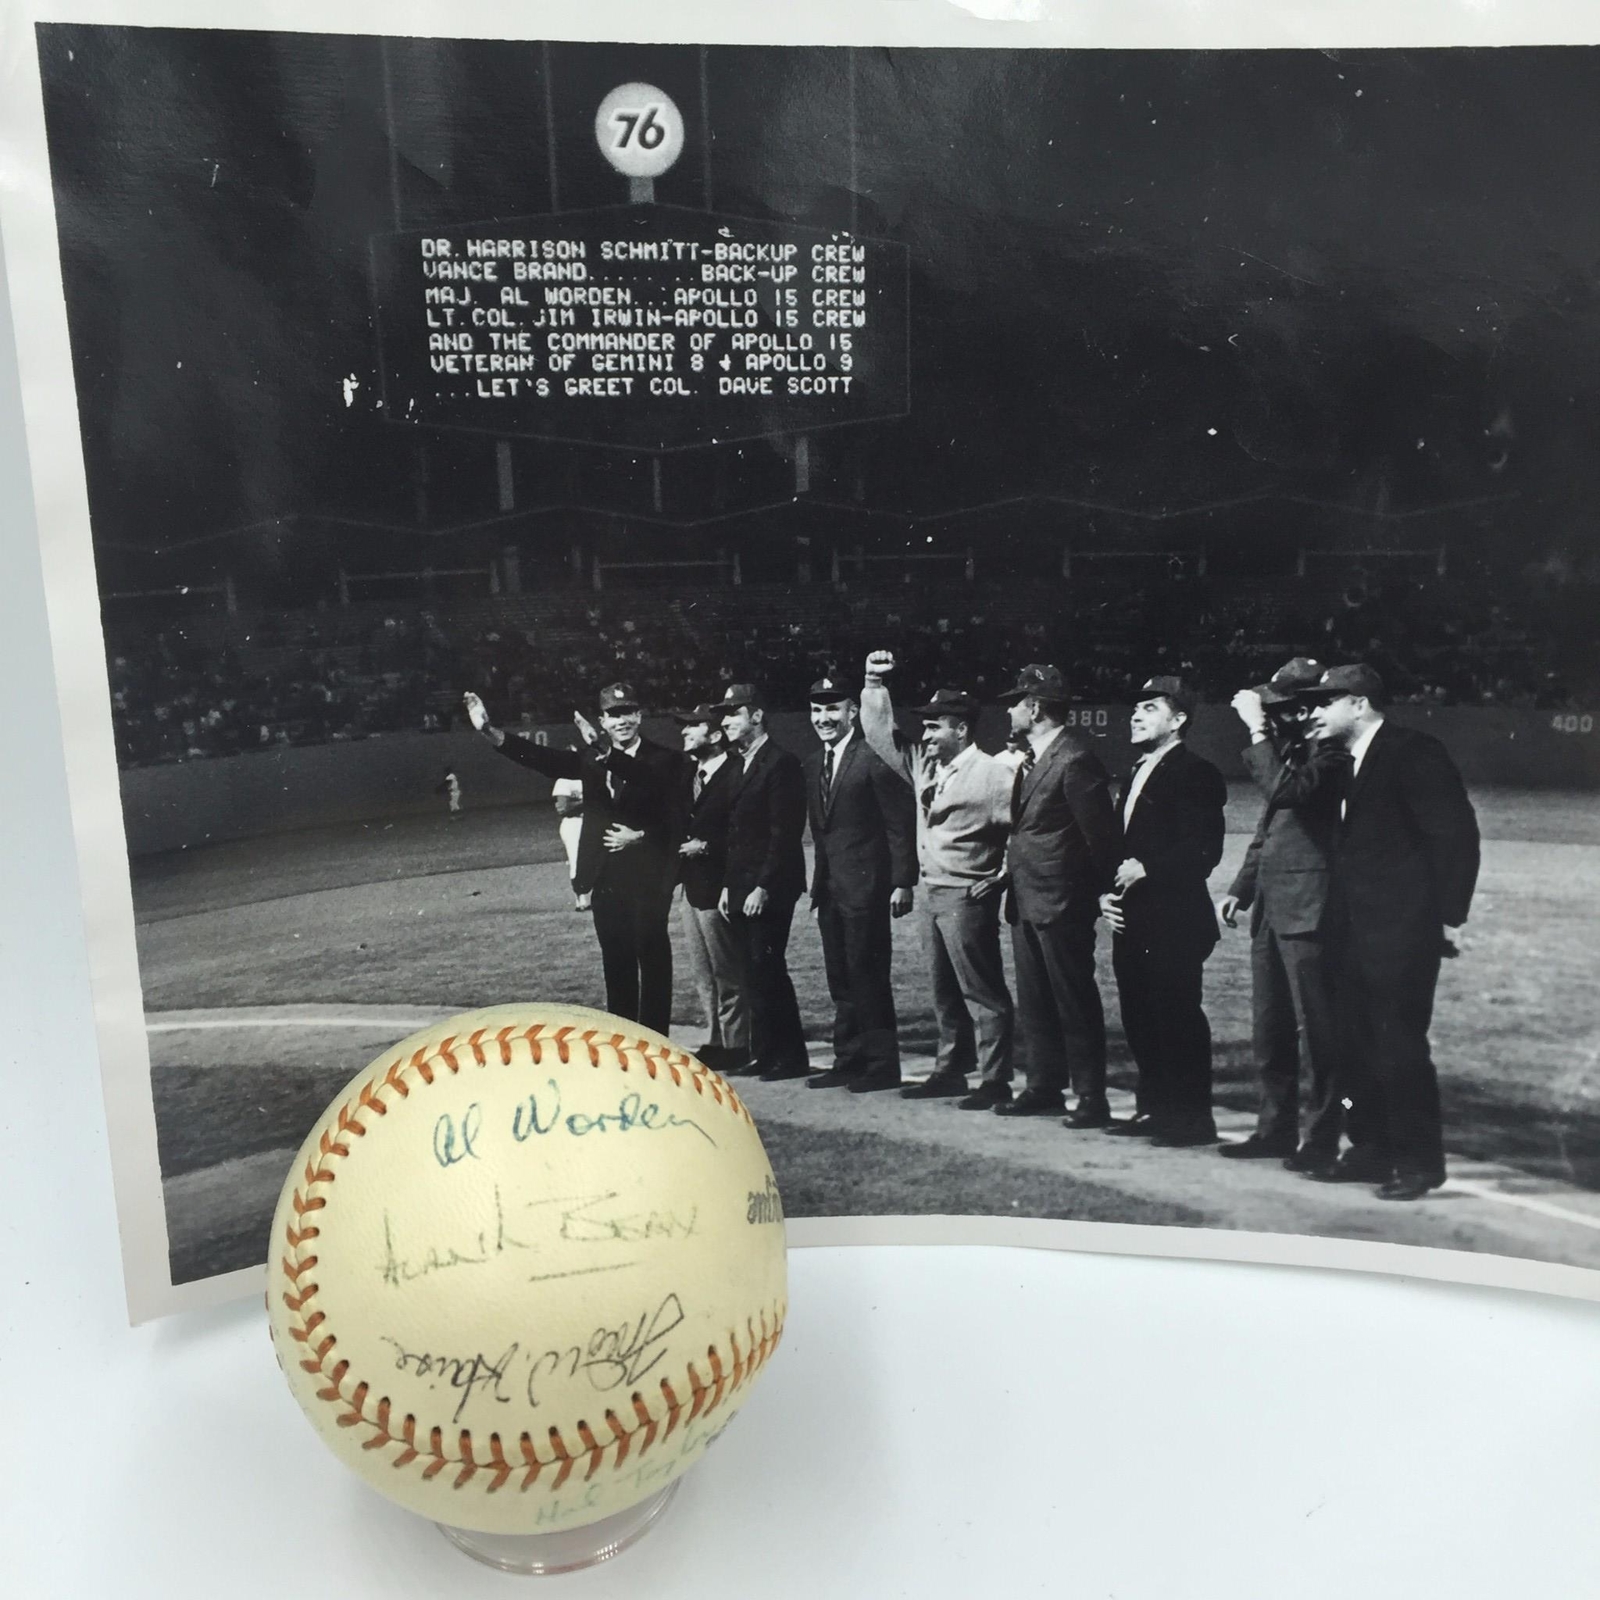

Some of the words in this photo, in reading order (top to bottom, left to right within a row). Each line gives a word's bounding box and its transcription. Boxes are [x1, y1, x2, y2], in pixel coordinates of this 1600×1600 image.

[614, 107, 666, 151] 76
[811, 243, 865, 264] CREW
[423, 261, 498, 281] VANCE
[812, 265, 865, 284] CREW
[425, 286, 477, 305] MAJ.
[501, 287, 529, 306] AL
[674, 288, 757, 307] APOLLO
[776, 289, 798, 307] 15
[812, 289, 865, 308] CREW
[776, 309, 798, 328] 15
[813, 309, 865, 328] CREW
[429, 333, 473, 352] AND
[489, 332, 531, 352] THE
[548, 333, 675, 352] COMMANDER
[690, 333, 716, 351] OF
[732, 333, 813, 352] APOLLO
[830, 333, 852, 352] 15
[431, 354, 535, 373] VETERAN
[549, 354, 576, 371] OF
[592, 353, 673, 372] GEMINI
[691, 354, 704, 372] 8
[746, 353, 826, 371] APOLLO
[840, 353, 853, 372] 9
[565, 377, 633, 396] GREET
[719, 377, 772, 395] DAVE
[787, 376, 852, 394] SCOTT
